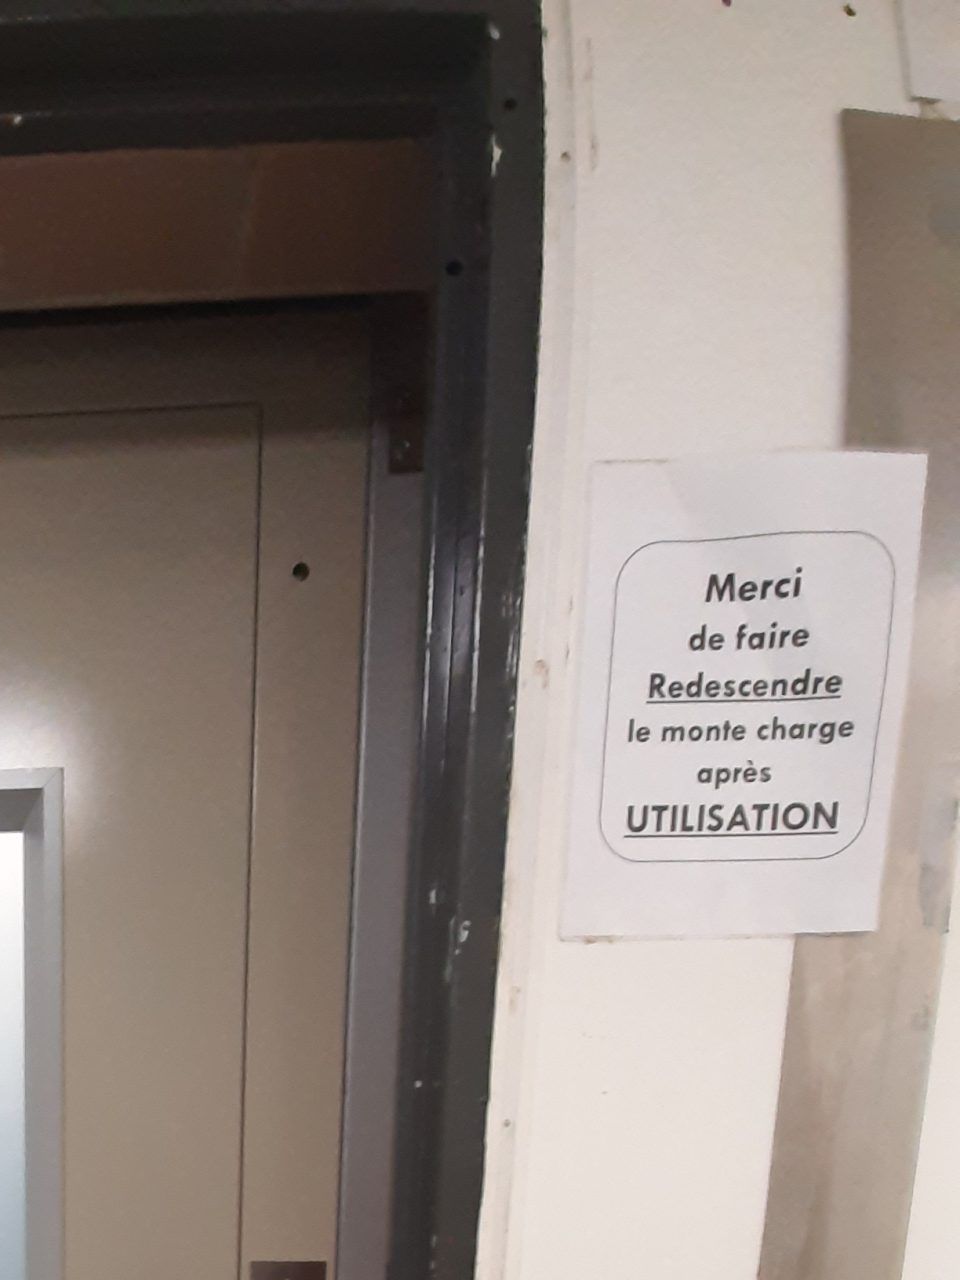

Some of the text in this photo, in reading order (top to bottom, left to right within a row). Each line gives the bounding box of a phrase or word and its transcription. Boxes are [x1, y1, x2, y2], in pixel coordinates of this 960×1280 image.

[705, 567, 802, 602] Merci
[689, 622, 809, 651] de faire
[649, 668, 842, 697] Redescendre
[628, 717, 854, 744] le monte charge
[698, 760, 771, 789] après
[628, 802, 838, 834] UTILISATION
